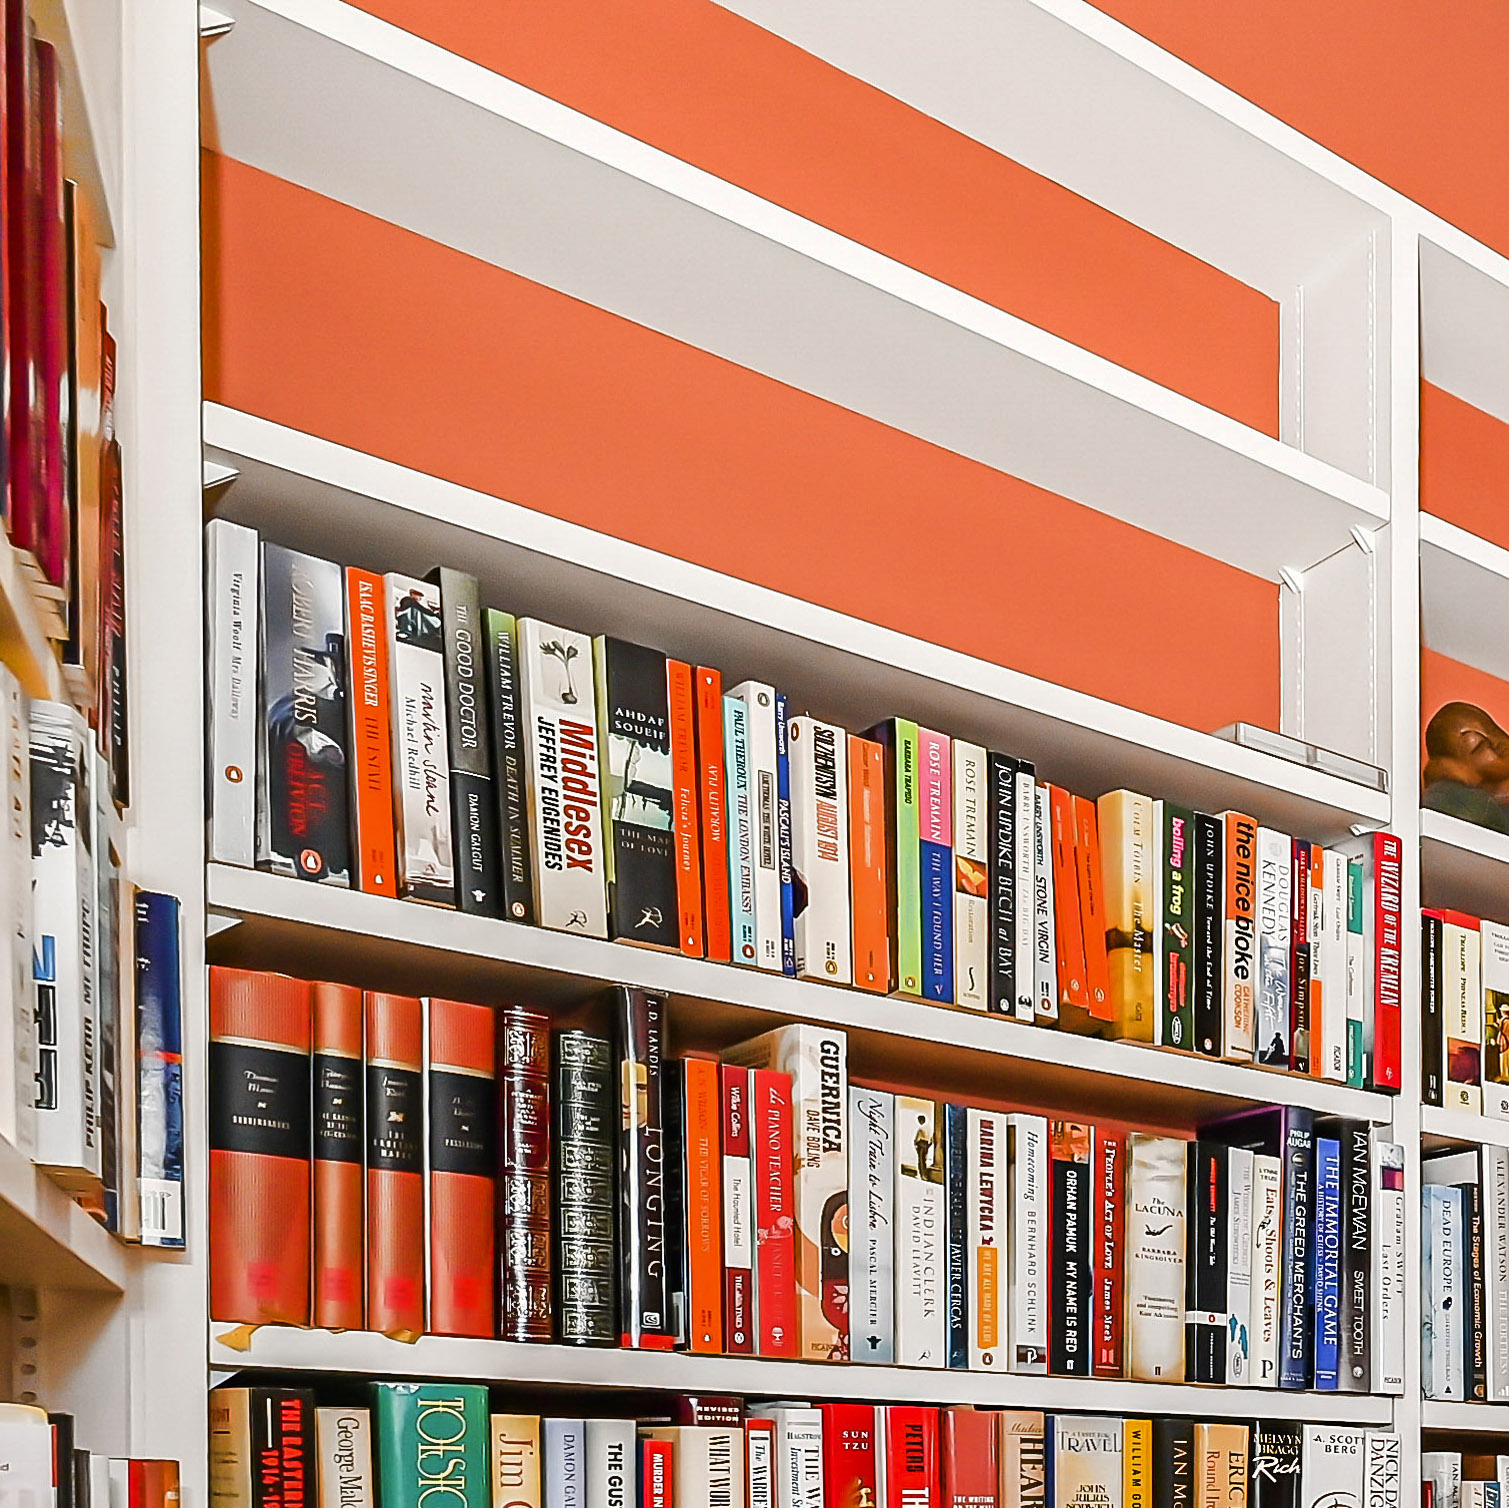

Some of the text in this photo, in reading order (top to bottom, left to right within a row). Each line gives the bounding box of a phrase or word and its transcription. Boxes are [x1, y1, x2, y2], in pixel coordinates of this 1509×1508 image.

[456, 629, 473, 681] GOOD
[458, 682, 477, 749] DOCTOR
[615, 708, 666, 727] AHDAF
[615, 720, 666, 741] SOUEIF
[537, 716, 562, 872] JEFFREY EUGENIDES
[559, 719, 599, 874] Middlesex
[1233, 822, 1256, 980] the nice bloke
[819, 1040, 842, 1154] GUERNICA
[645, 1126, 663, 1280] LONGING
[1134, 1204, 1184, 1217] LACUNA
[1065, 1170, 1078, 1354] ORHAN PAMUK MY NAME IS RED
[1351, 1132, 1367, 1356] IAN McEWAN SWEET TOOTH
[499, 1433, 534, 1489] Jim
[608, 1443, 622, 1470] THE
[843, 1430, 869, 1439] SUN
[844, 1441, 870, 1450] TZU
[1173, 1440, 1188, 1475] IAN
[1251, 1456, 1301, 1481] Rich
